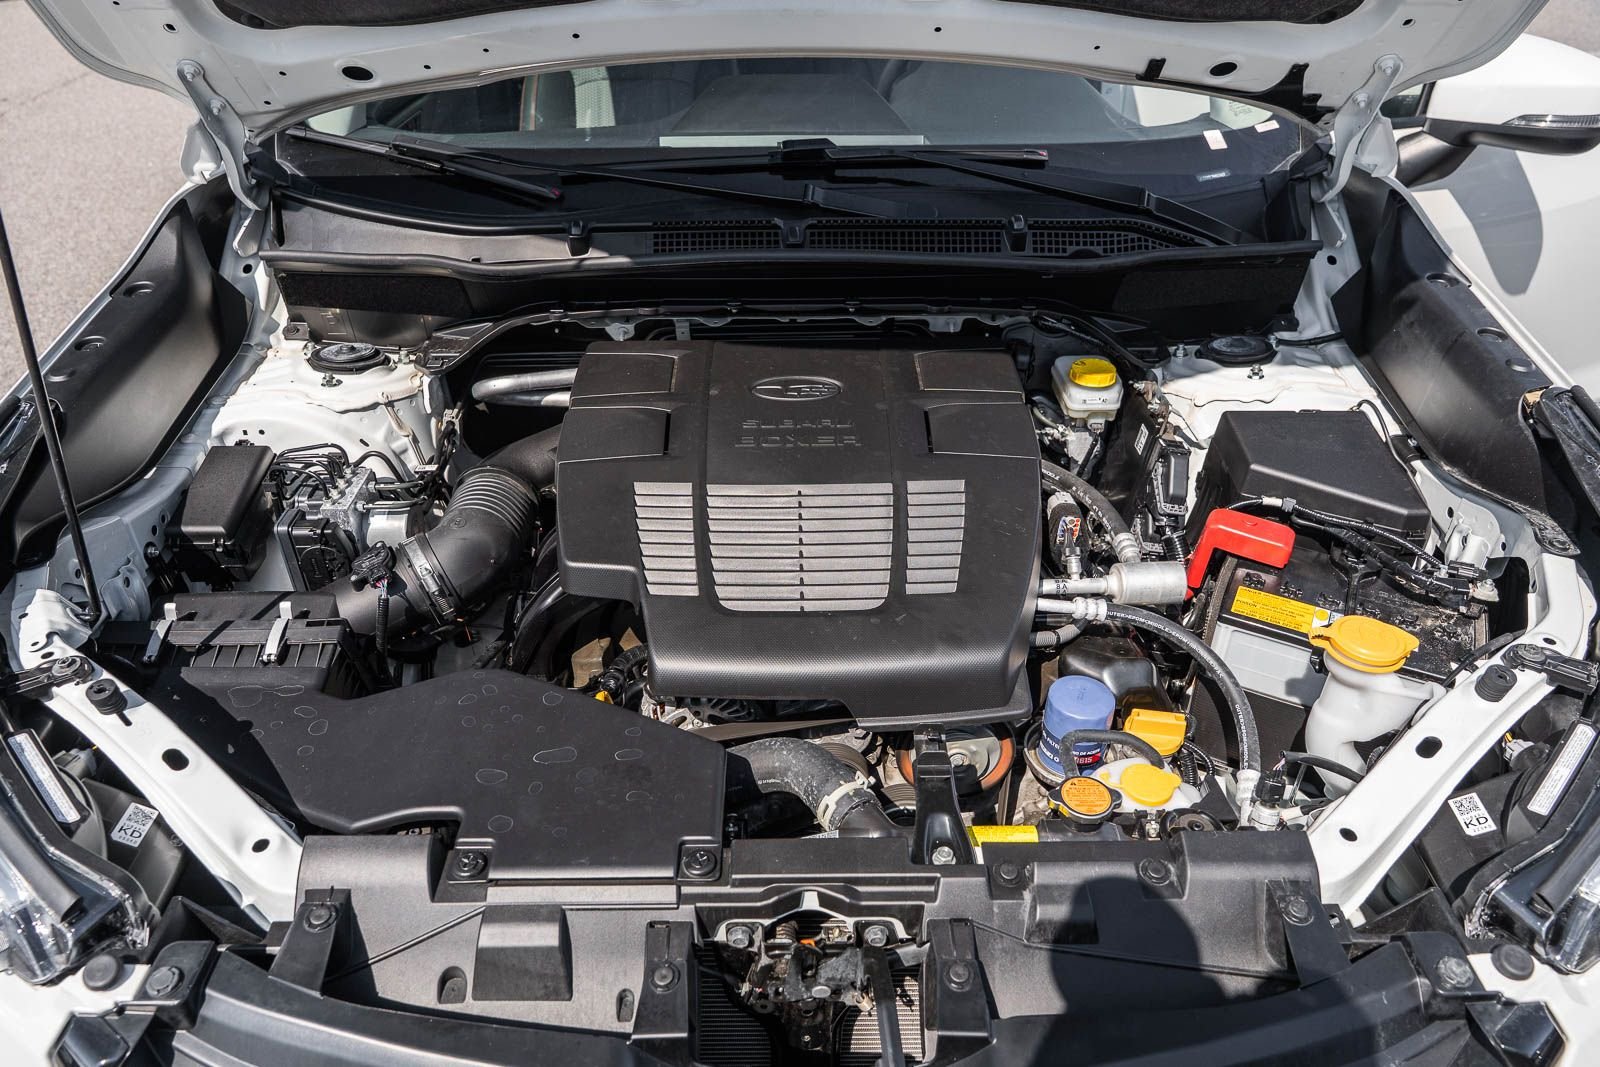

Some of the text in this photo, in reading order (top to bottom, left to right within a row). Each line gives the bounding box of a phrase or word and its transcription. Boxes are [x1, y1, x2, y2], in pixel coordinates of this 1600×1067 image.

[741, 417, 855, 428] SUBARU
[734, 433, 863, 447] BOXER
[1464, 816, 1488, 829] KD
[118, 825, 142, 839] KD
